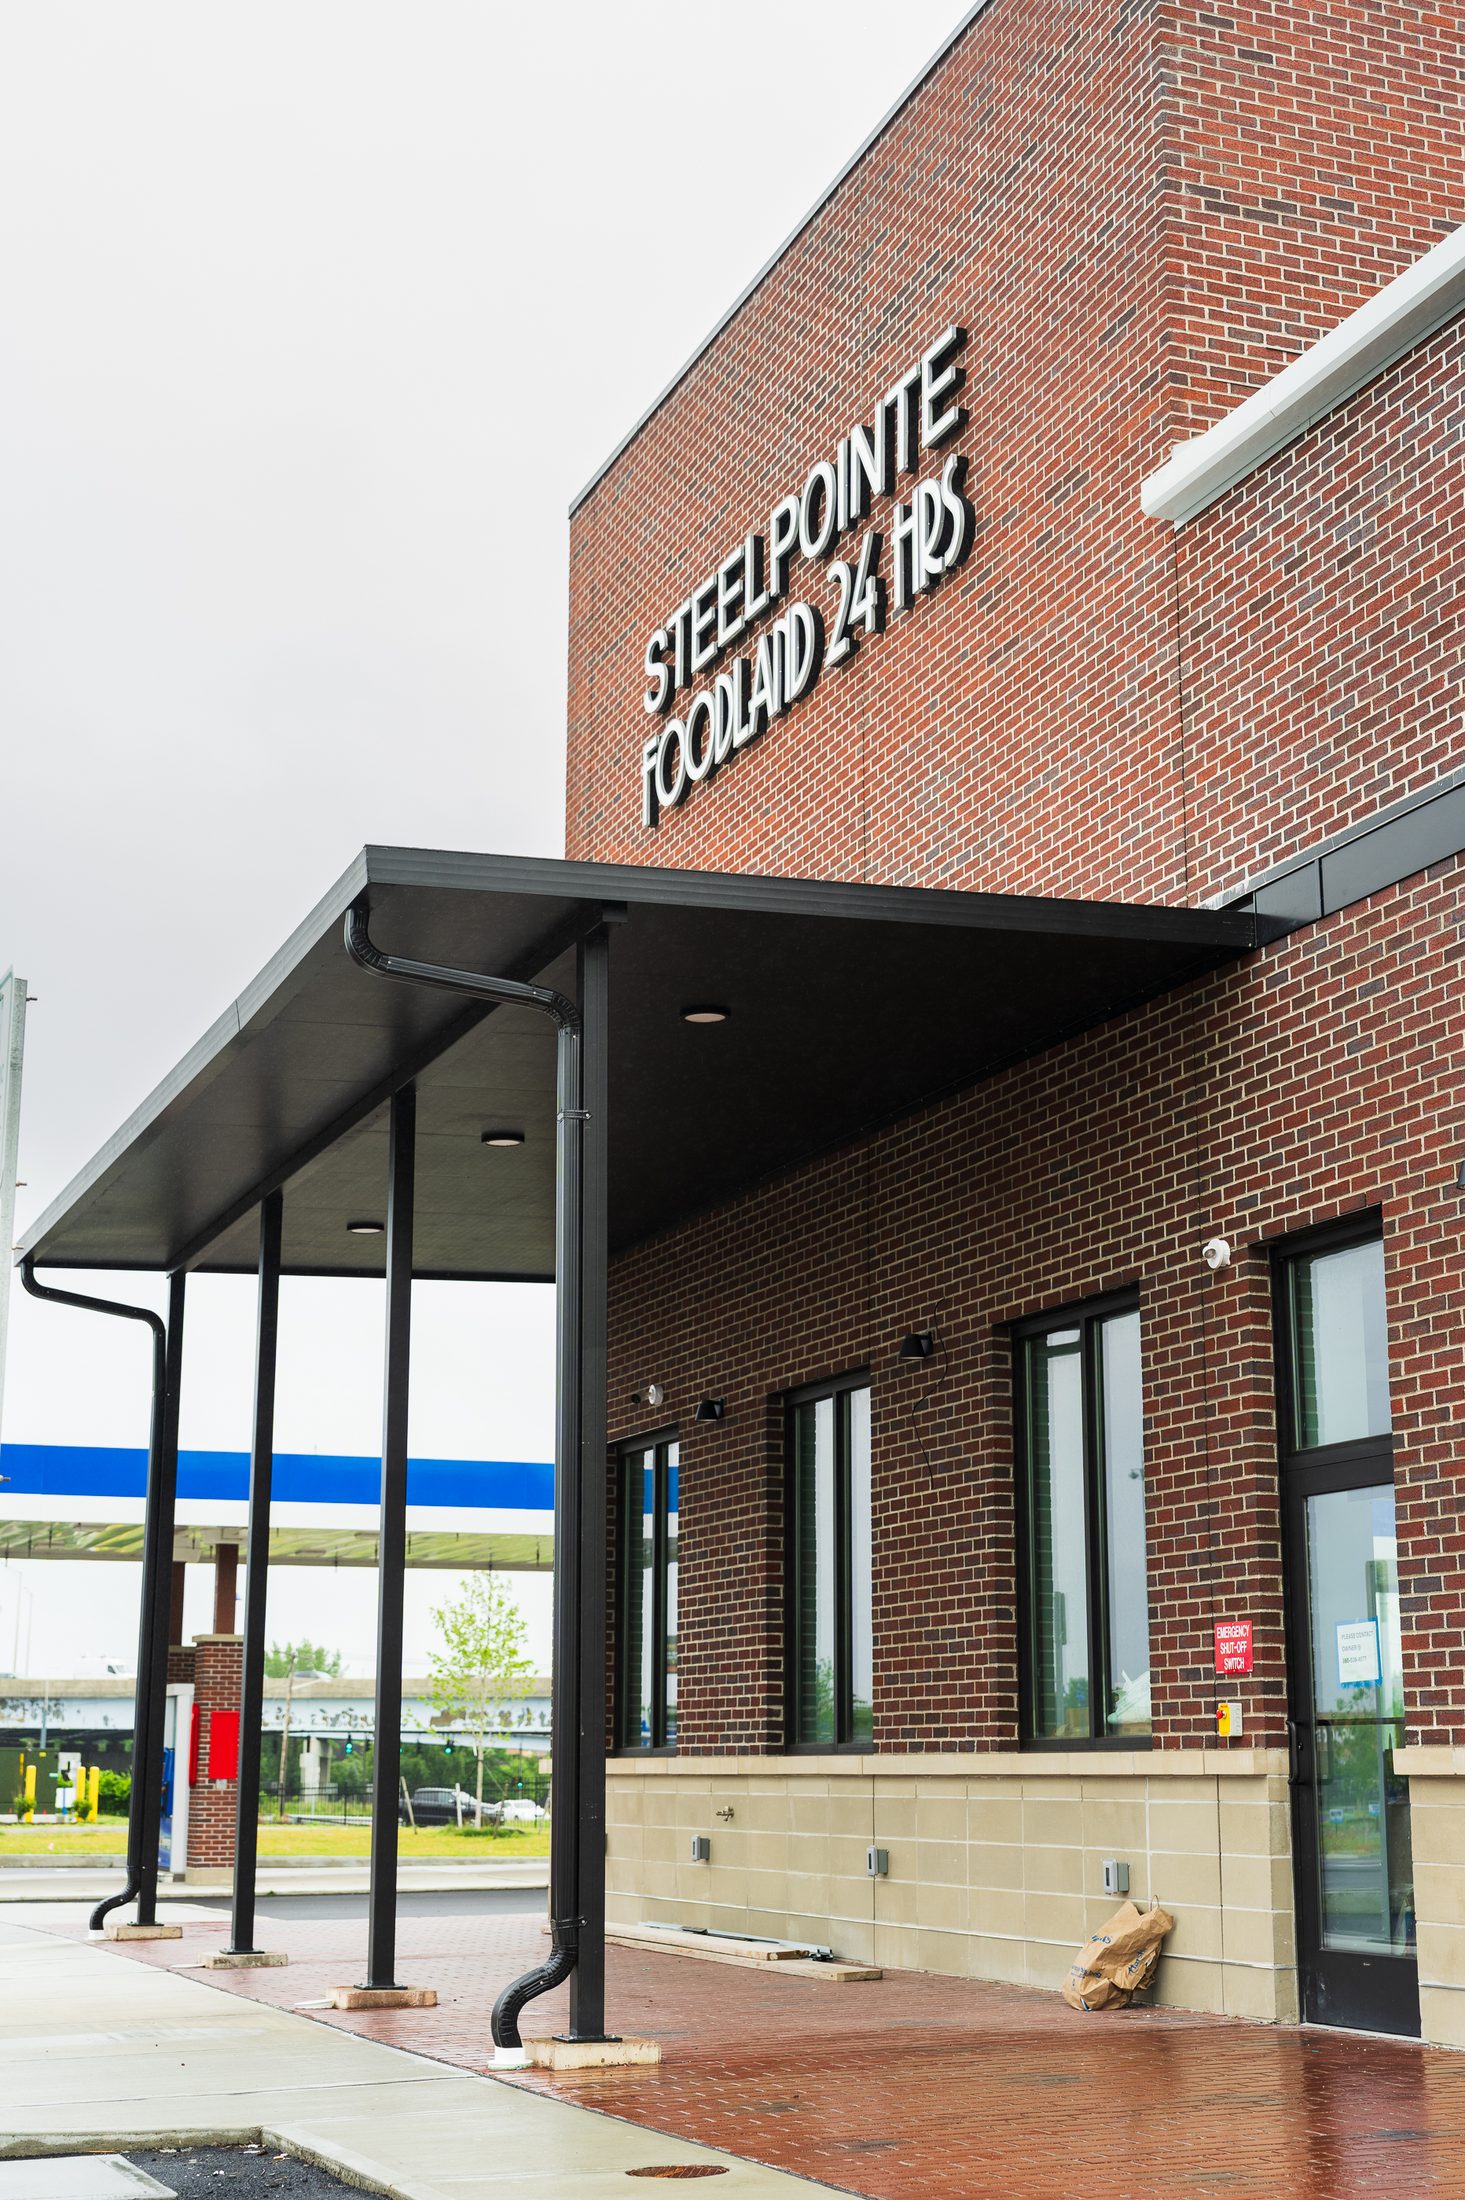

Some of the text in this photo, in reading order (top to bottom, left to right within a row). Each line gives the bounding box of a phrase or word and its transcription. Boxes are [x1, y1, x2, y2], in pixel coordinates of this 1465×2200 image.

[643, 324, 967, 714] STEELPOINTE
[824, 531, 885, 668] 24
[892, 452, 975, 610] HRS
[1216, 1624, 1250, 1639] EMERGENCY
[1219, 1640, 1247, 1655] SHUT-OFF
[1223, 1657, 1245, 1670] SWITCH
